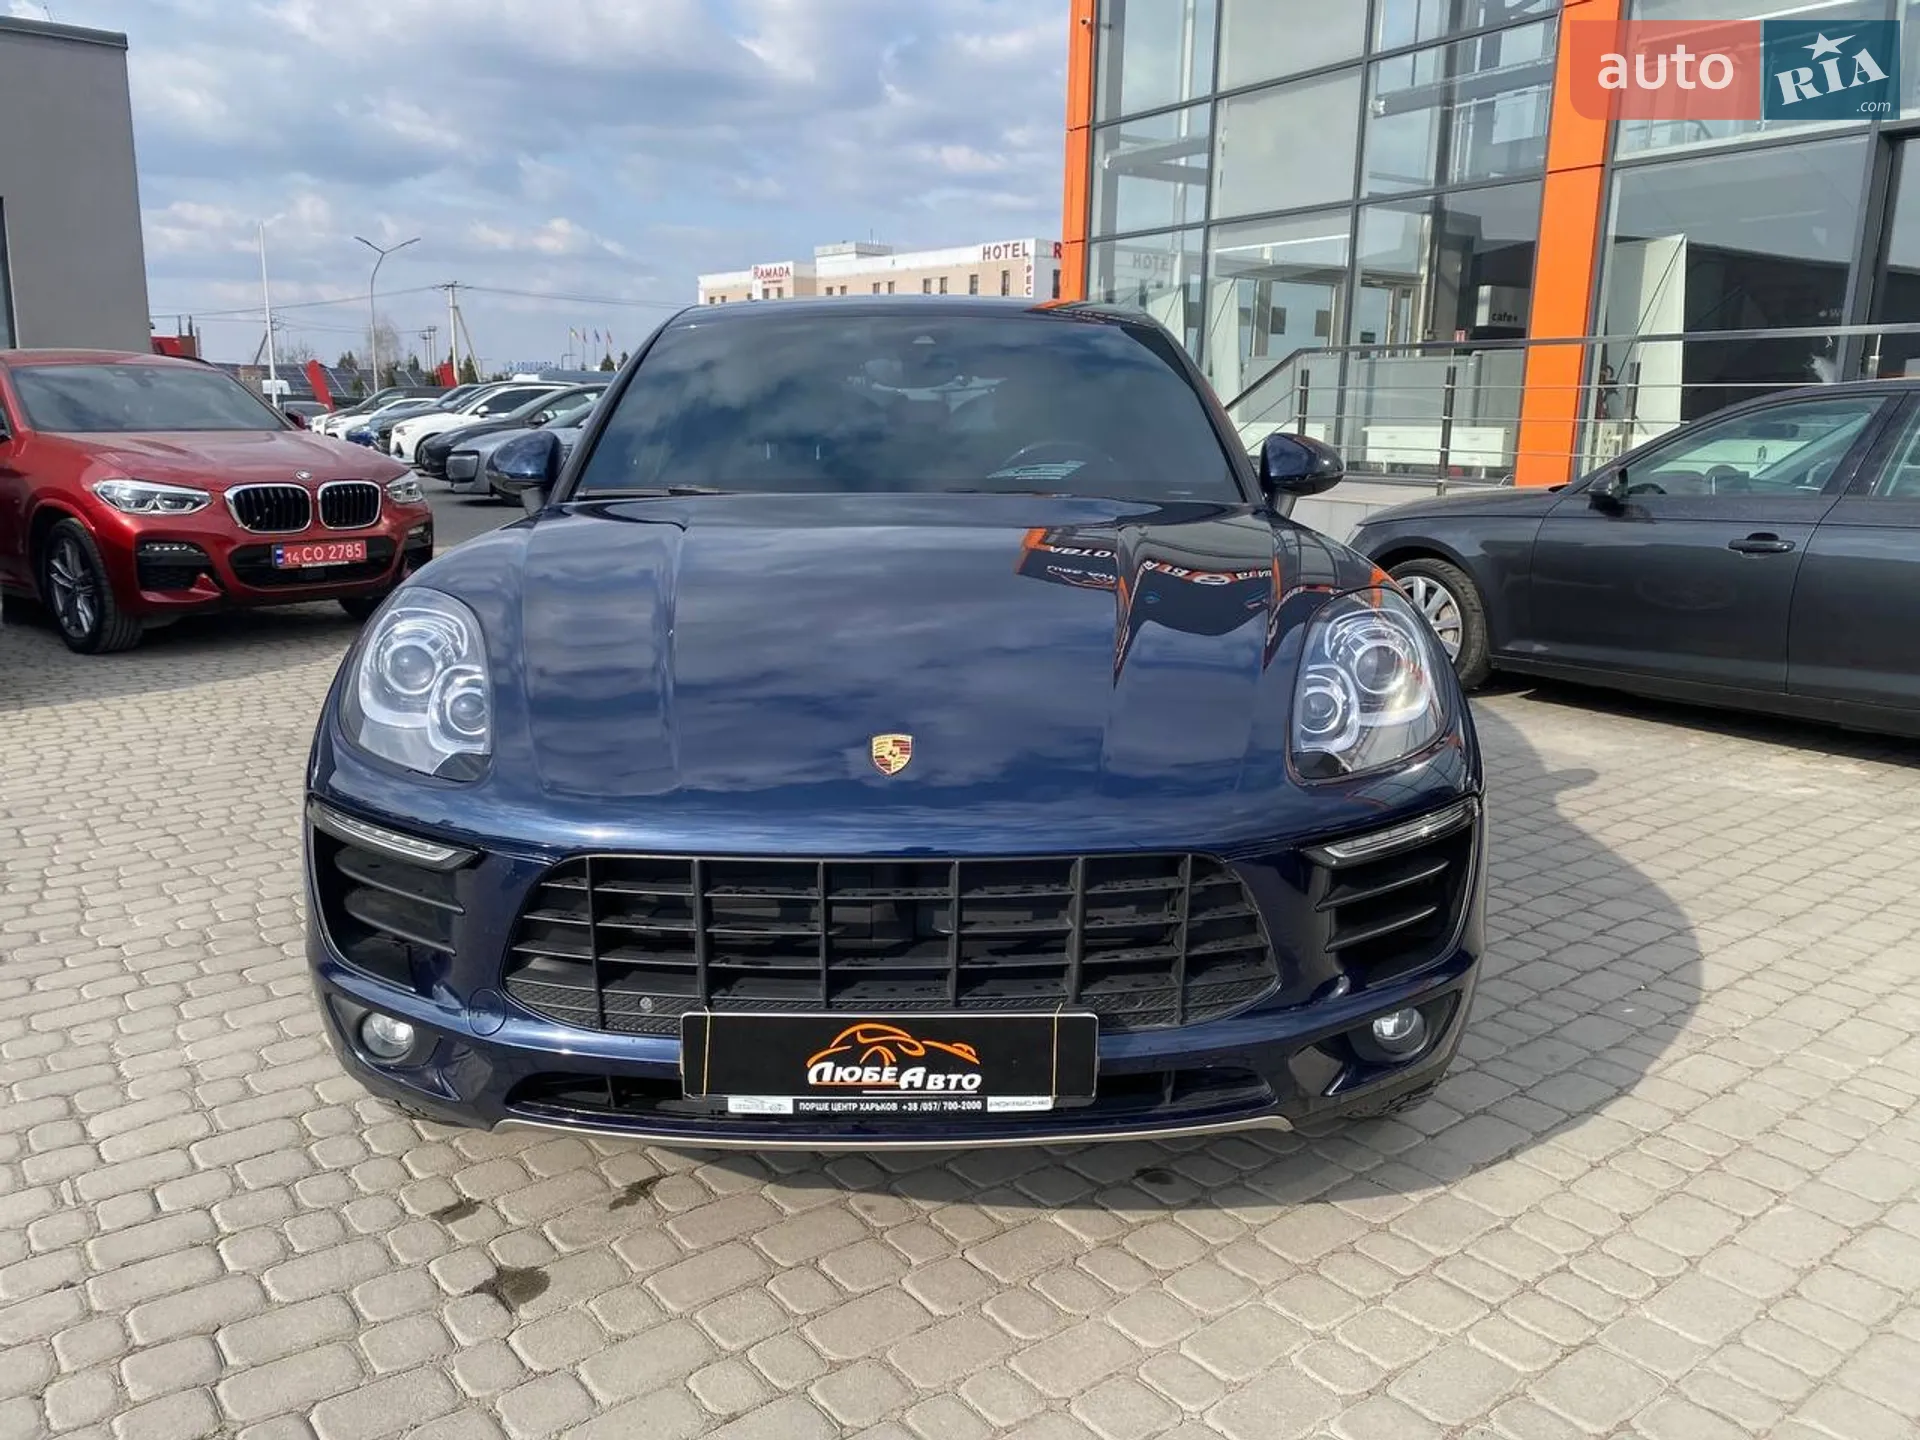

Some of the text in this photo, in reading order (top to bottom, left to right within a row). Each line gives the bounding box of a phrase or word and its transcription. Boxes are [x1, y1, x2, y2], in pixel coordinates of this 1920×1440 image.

[983, 242, 1029, 260] HOTEL
[753, 264, 791, 280] RAMADA
[285, 551, 300, 565] 14
[328, 542, 362, 560] 2785
[800, 1101, 829, 1112] ПОРШЕ
[832, 1101, 857, 1112] ЦЕНТР
[859, 1101, 898, 1112] ХАРЬКОВ
[901, 1101, 918, 1112] +38
[943, 1099, 982, 1111] 700-2000
